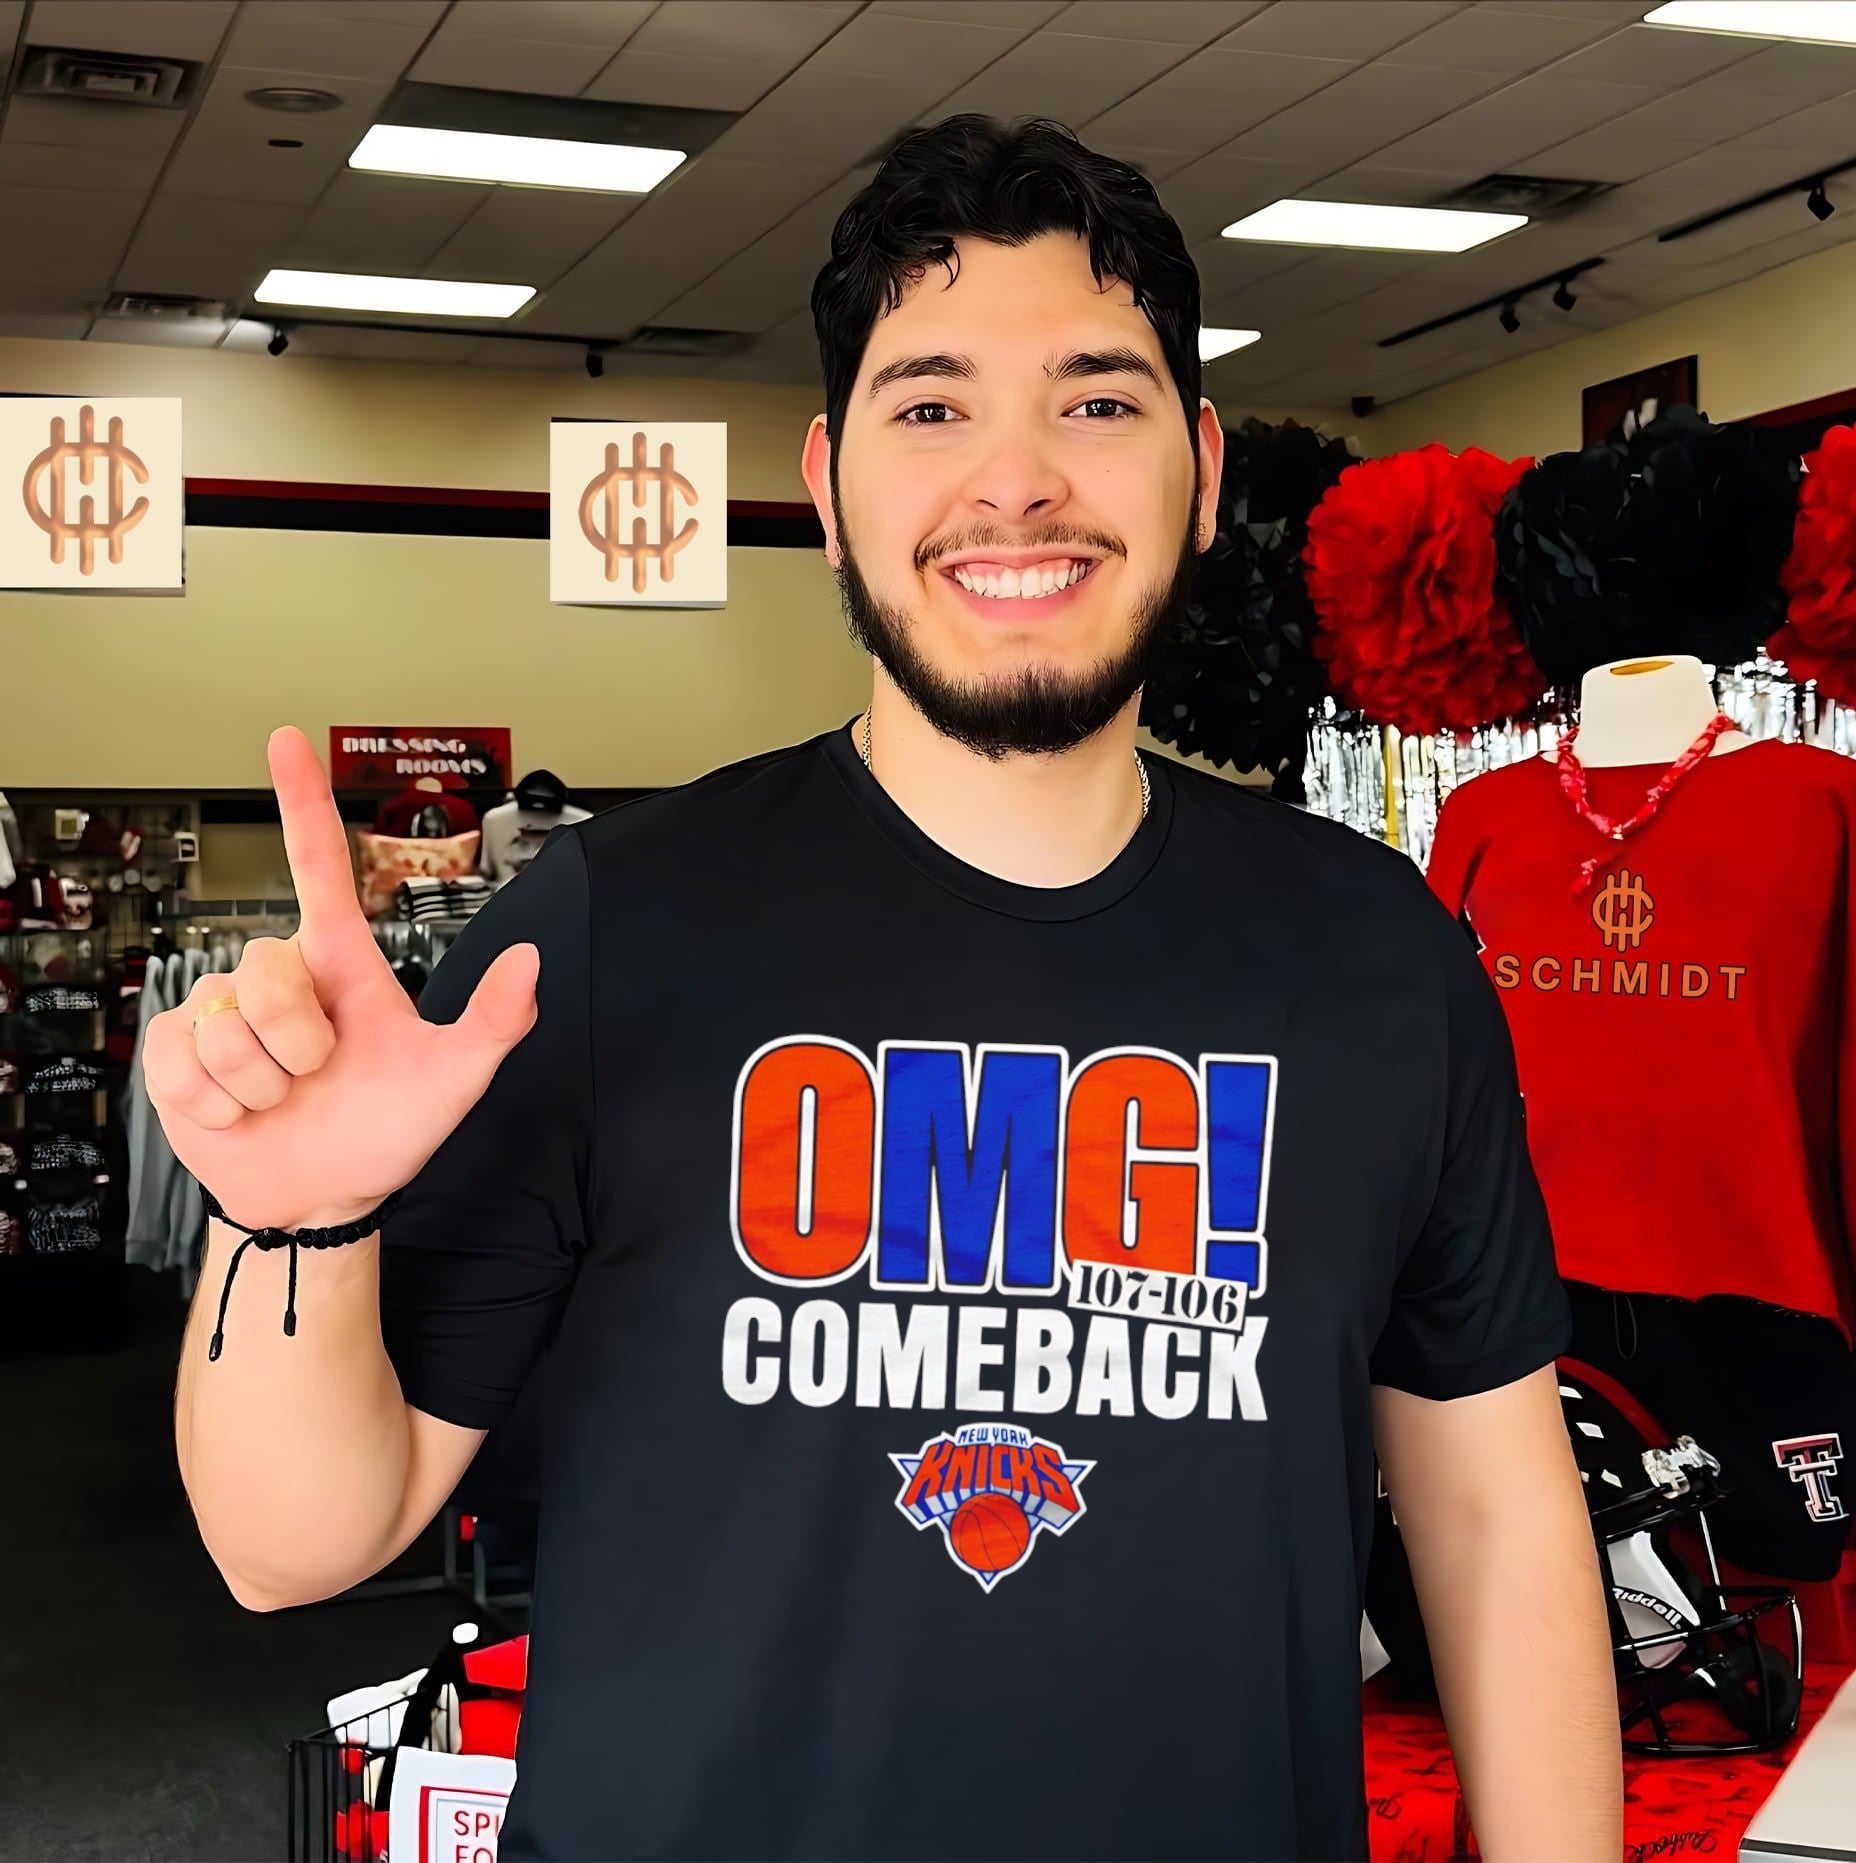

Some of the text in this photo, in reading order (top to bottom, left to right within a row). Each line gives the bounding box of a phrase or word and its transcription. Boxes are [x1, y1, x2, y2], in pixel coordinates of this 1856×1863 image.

[396, 758, 487, 774] ROOMS
[1494, 953, 1747, 1000] SCHMIDT
[729, 1034, 1279, 1297] OMG!
[1076, 1265, 1239, 1324] 107-106
[722, 1296, 1269, 1421] COMEBACK
[957, 1427, 1029, 1446] NEW YORK
[901, 1440, 1081, 1515] KNICKS
